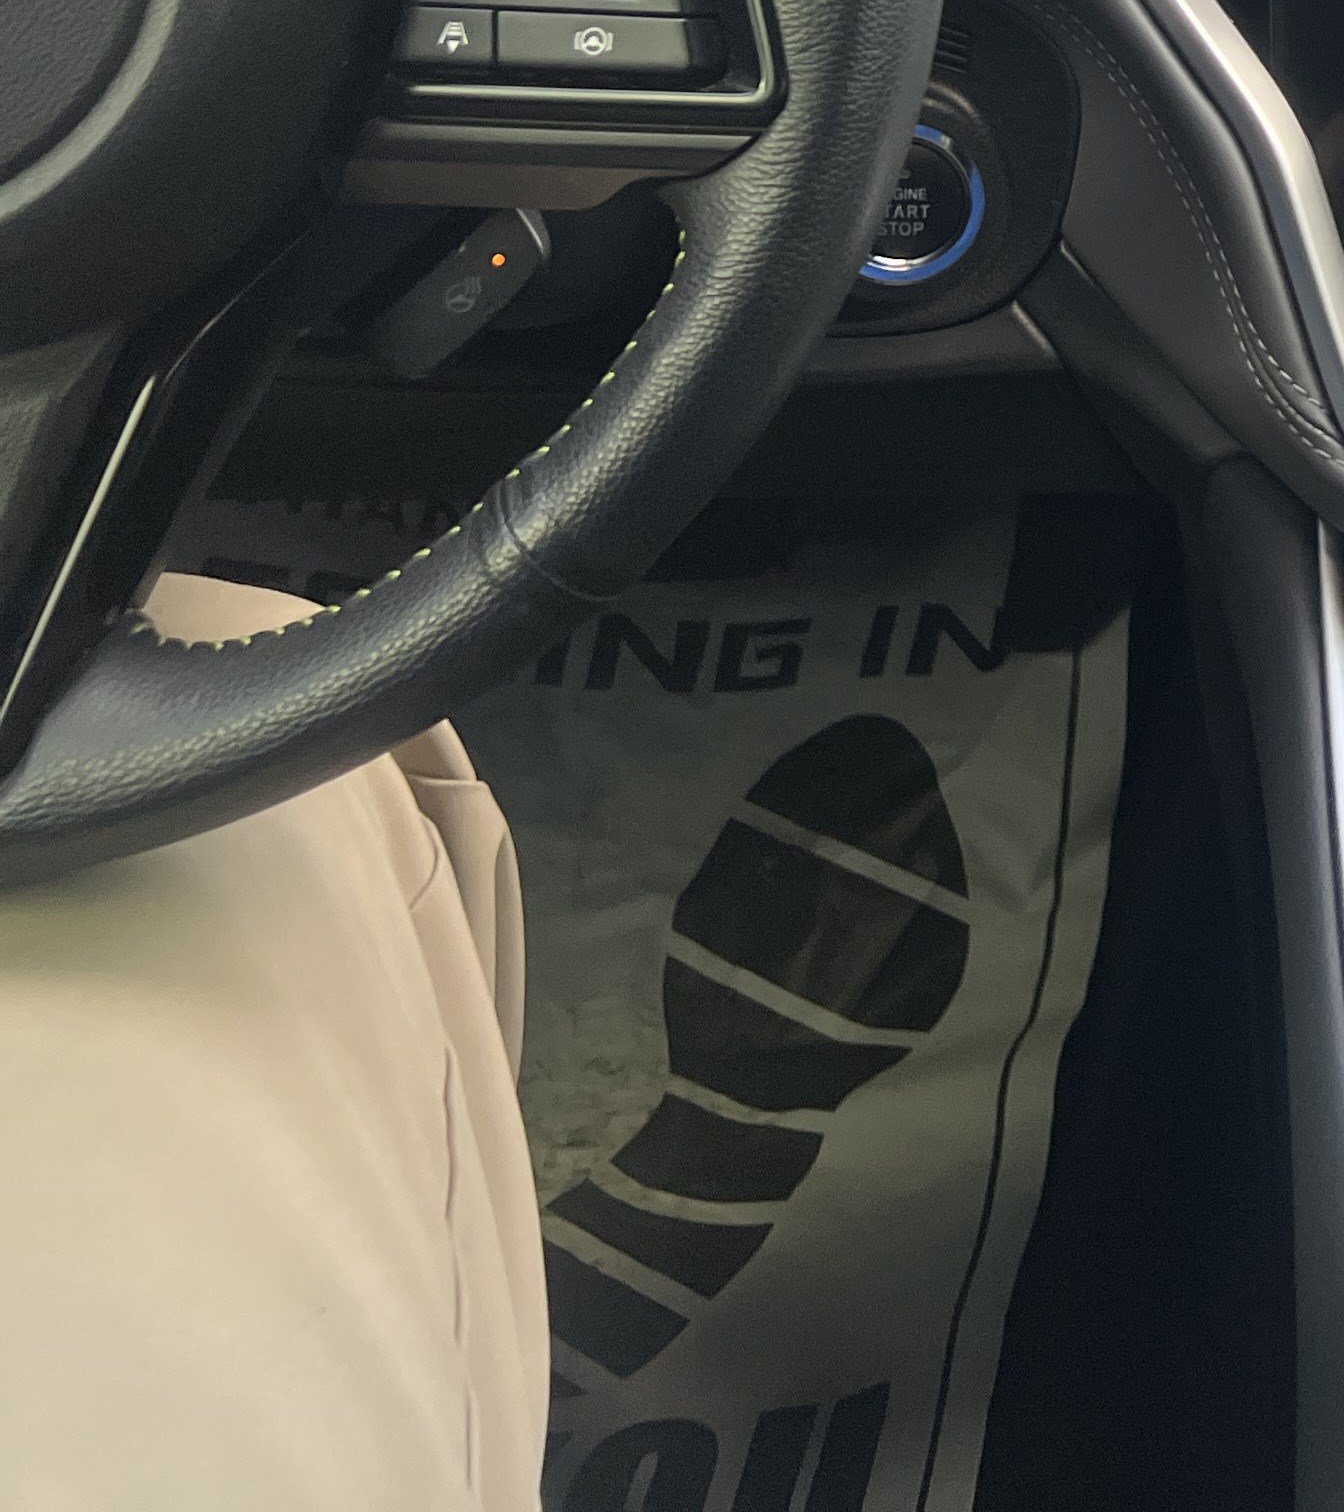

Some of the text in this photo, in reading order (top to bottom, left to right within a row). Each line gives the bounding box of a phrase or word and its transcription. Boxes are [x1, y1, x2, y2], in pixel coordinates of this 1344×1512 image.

[894, 187, 928, 202] GINE
[886, 203, 931, 220] TART
[534, 602, 1004, 693] ING IN
